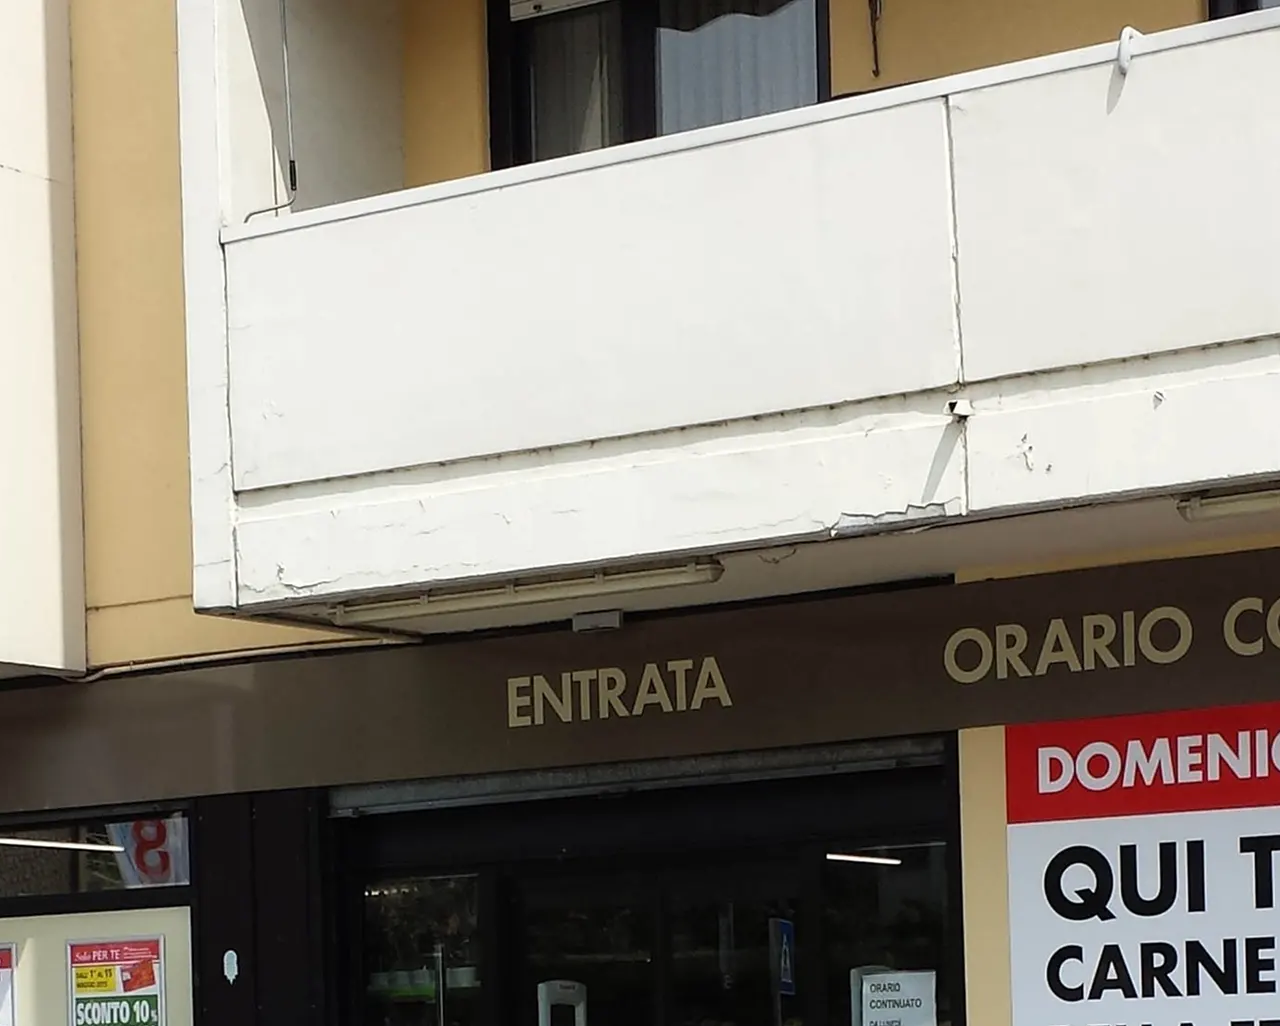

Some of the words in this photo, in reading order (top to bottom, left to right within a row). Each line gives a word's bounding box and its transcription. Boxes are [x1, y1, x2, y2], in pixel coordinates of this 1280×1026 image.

[943, 605, 1193, 684] ORARIO
[507, 656, 733, 728] ENTRATA
[1043, 840, 1206, 922] QUI
[92, 950, 108, 961] PER
[111, 949, 120, 960] TE
[1046, 936, 1277, 1002] CARNE
[869, 983, 901, 993] ORARIO
[869, 998, 922, 1009] CONTINUATO
[77, 1001, 130, 1025] SCONTO
